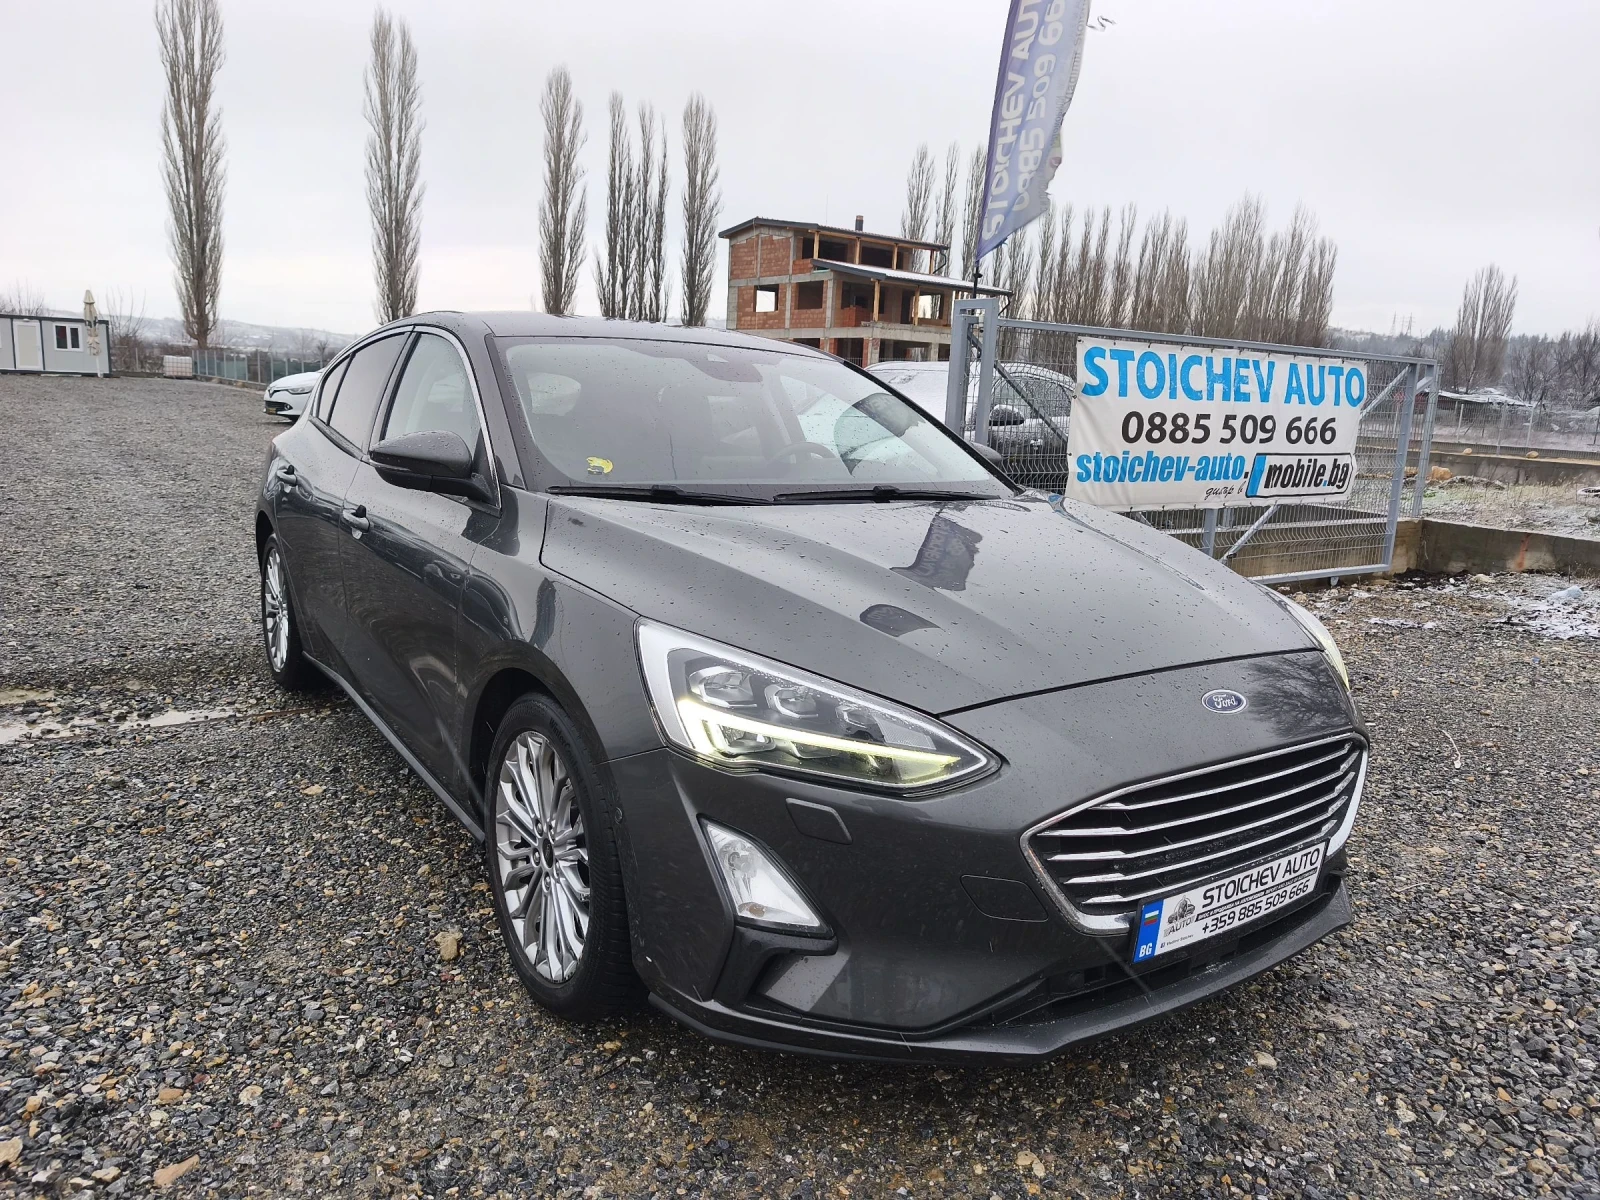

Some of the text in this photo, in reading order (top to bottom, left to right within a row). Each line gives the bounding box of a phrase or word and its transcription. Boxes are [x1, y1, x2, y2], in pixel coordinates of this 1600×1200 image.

[1026, 53, 1057, 120] 509
[982, 71, 1026, 240] STOICHEV
[1012, 128, 1045, 211] 0885
[1081, 346, 1365, 407] STOICHEV AUTO
[1121, 411, 1336, 445] 0885 509 666
[1264, 458, 1350, 490] mobile.bg
[1212, 694, 1237, 709] Ford
[1202, 863, 1281, 909] STOICHEV
[1282, 848, 1321, 878] AUTO
[1202, 910, 1236, 934] +359
[1238, 900, 1263, 921] 885
[1264, 890, 1287, 911] 509
[1289, 879, 1311, 899] 666
[1139, 943, 1153, 957] BG
